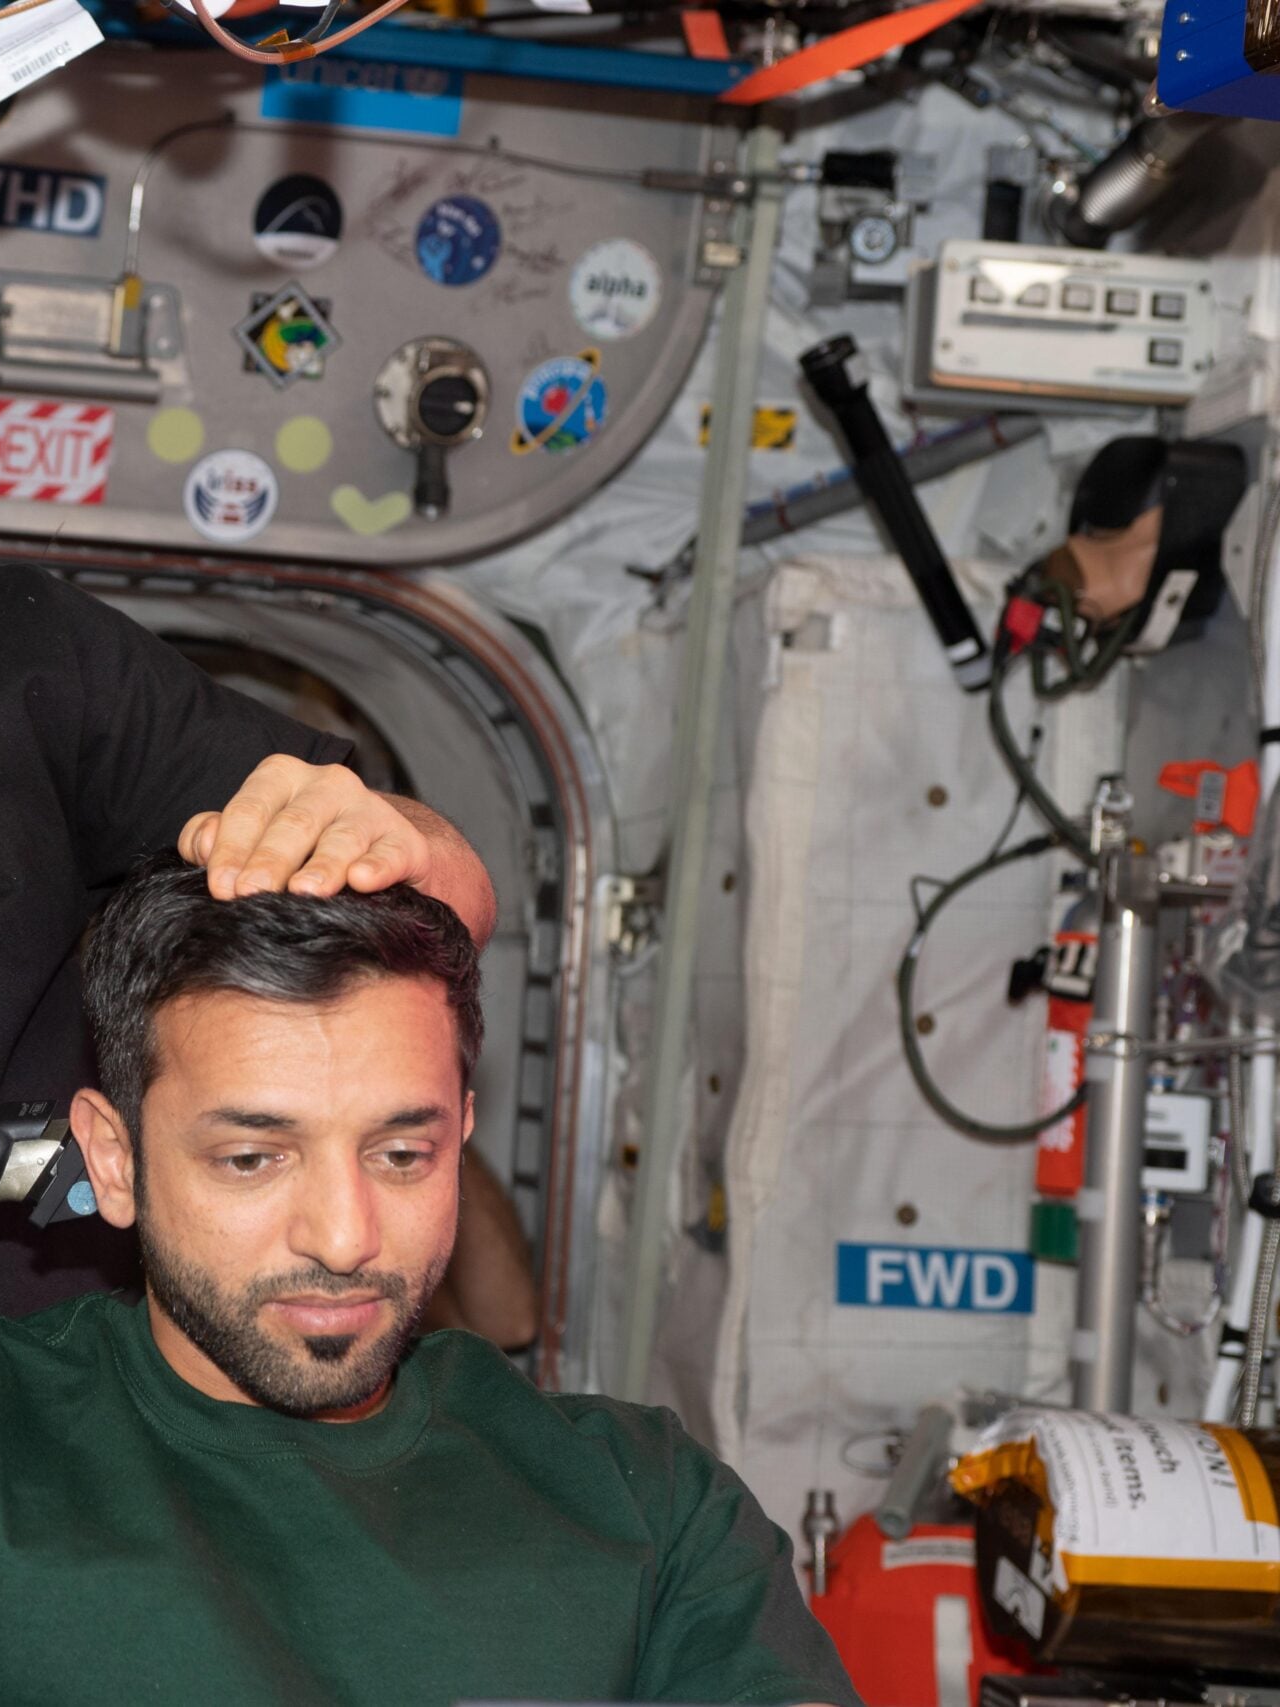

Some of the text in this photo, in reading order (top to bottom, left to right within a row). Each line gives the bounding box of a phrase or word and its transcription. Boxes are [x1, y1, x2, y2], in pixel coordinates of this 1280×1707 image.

[585, 270, 648, 302] alpha
[0, 424, 94, 481] EXIT
[867, 1250, 1018, 1310] FWD
